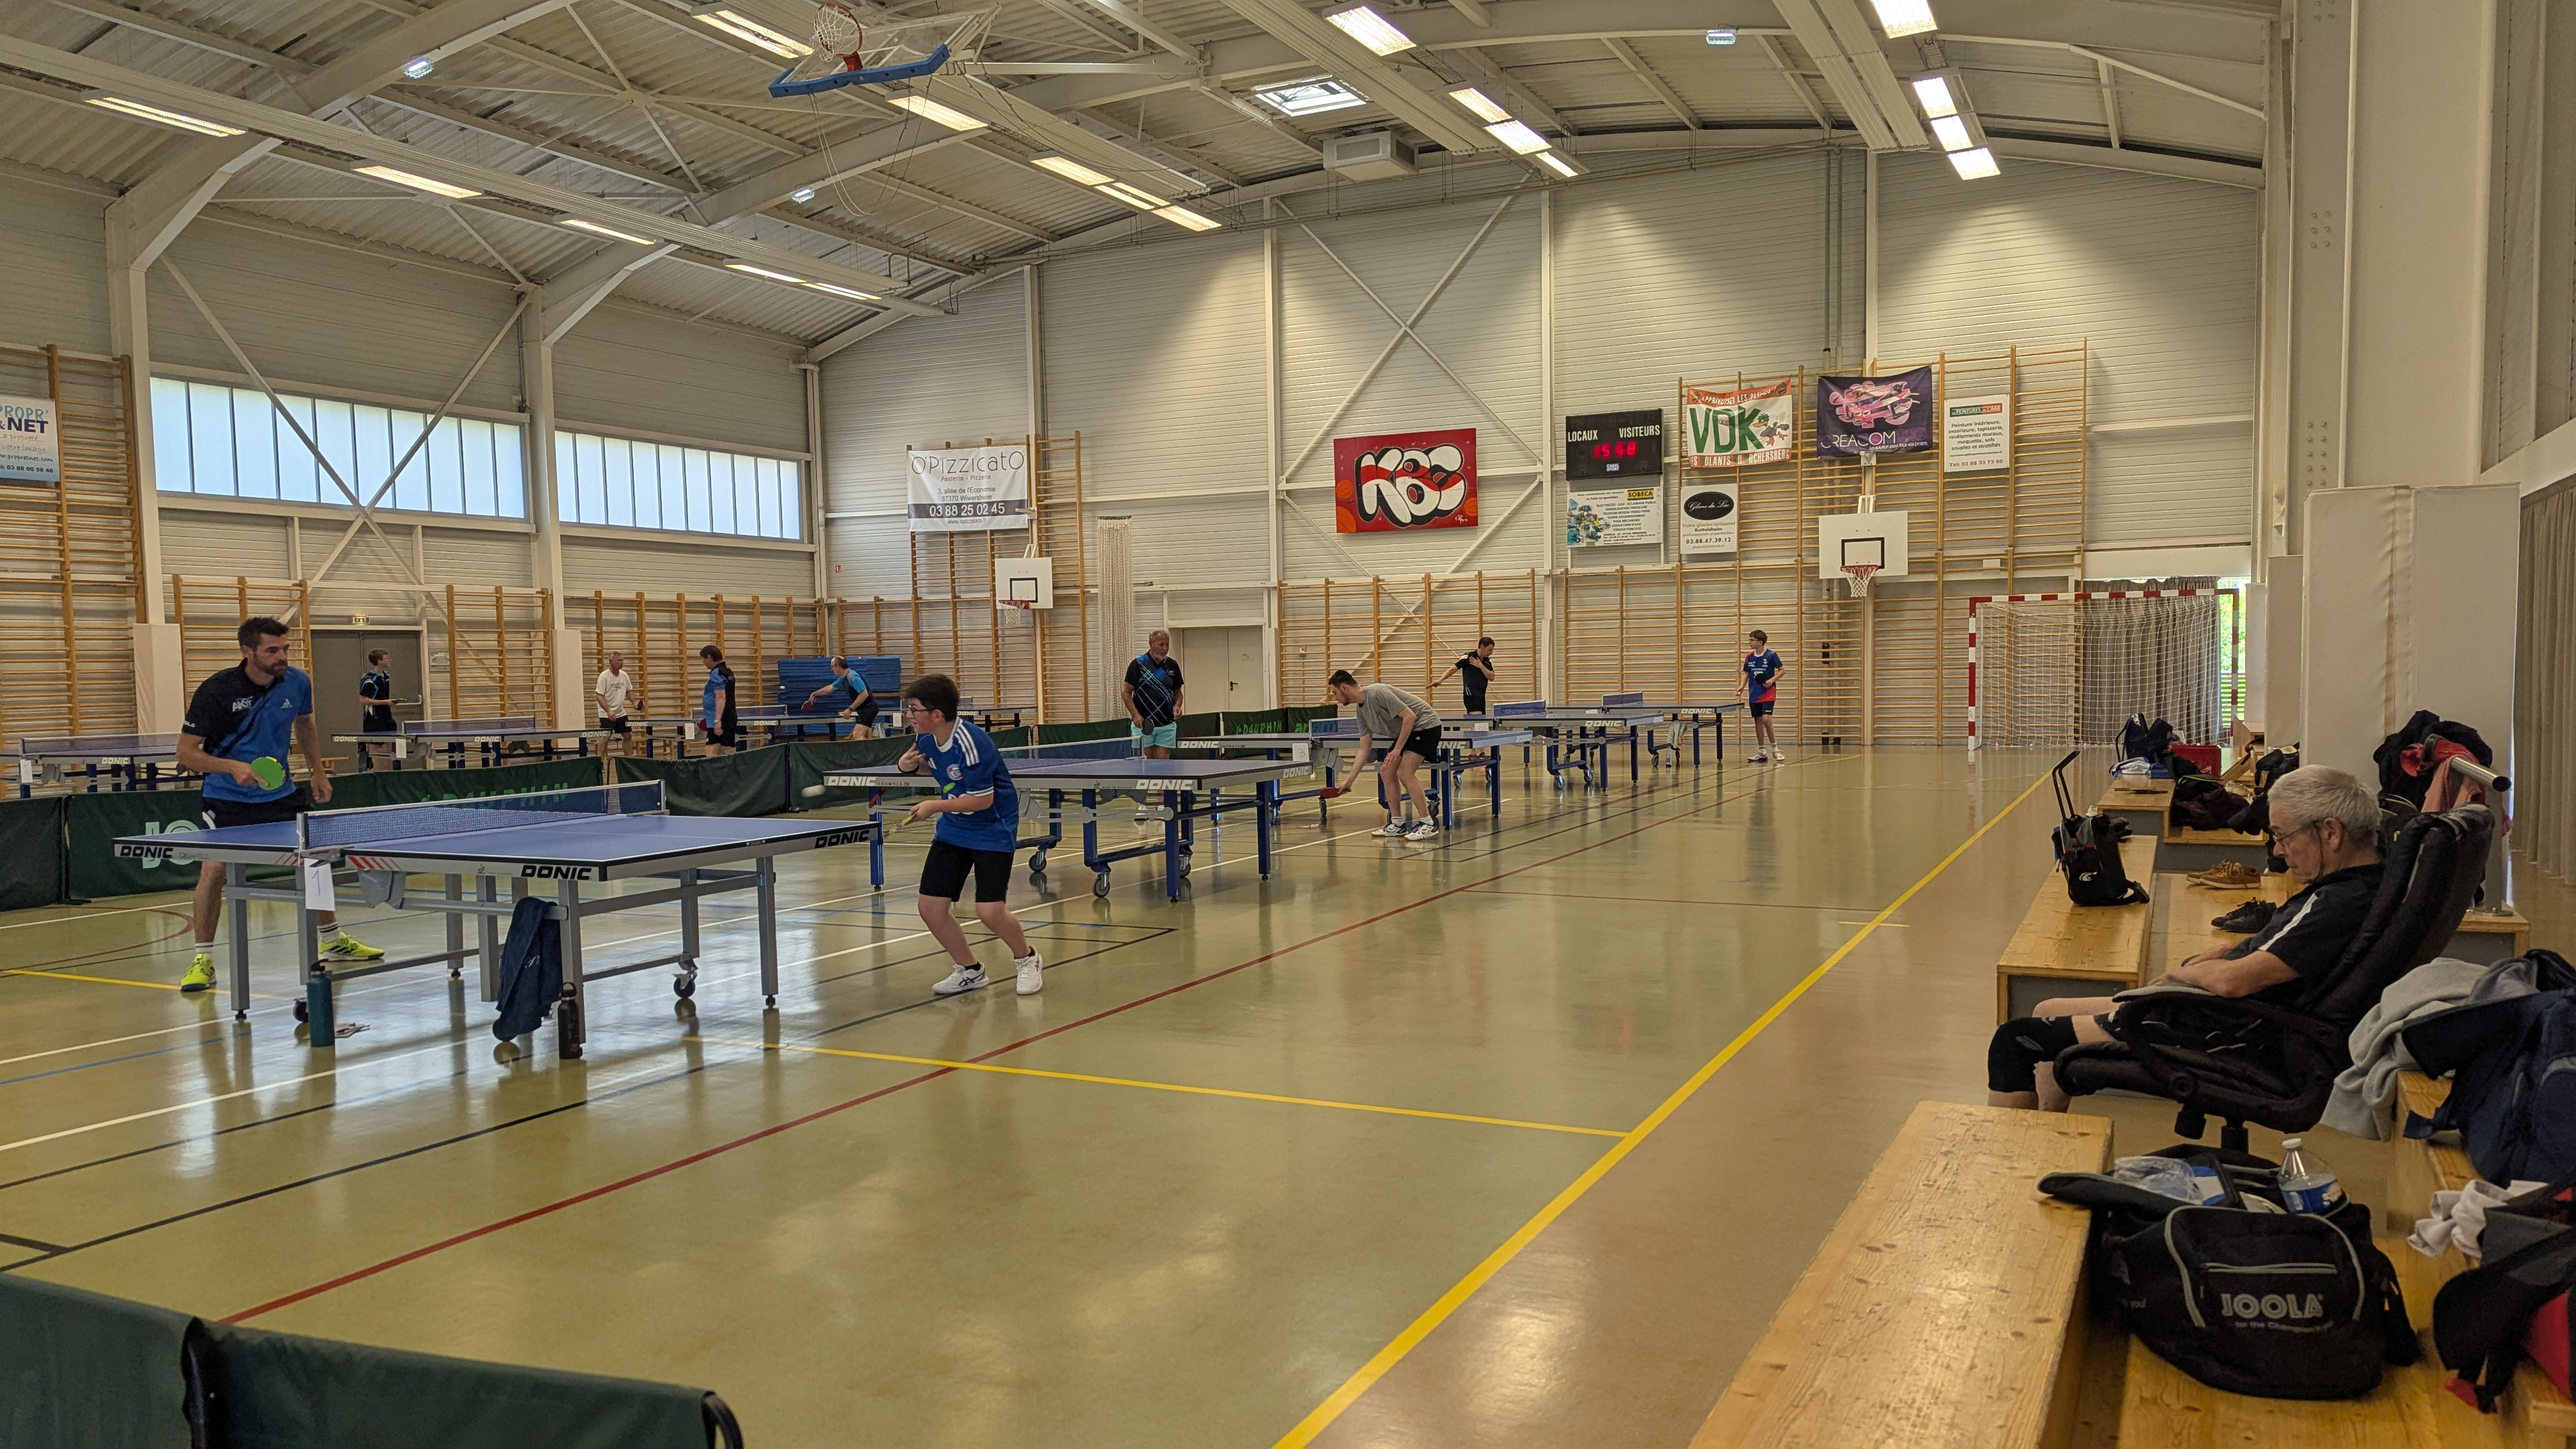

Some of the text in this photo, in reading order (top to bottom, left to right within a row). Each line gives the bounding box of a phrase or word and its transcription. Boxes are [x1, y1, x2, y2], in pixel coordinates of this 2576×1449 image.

[1701, 395, 1735, 405] APPRIVOISER
[1737, 394, 1747, 403] LES
[8, 417, 49, 433] NET
[1689, 405, 1765, 454] VDK
[1568, 425, 1660, 442] LOCAUX VISITEURS
[930, 502, 1005, 516] 03 88 25 02 45
[1243, 721, 1282, 735] DAUPHIN
[1298, 748, 1305, 757] 3
[1283, 766, 1310, 779] DONIC
[827, 776, 876, 786] DONIC
[1136, 779, 1193, 790] DONIC
[814, 830, 870, 848] DONIC
[120, 846, 173, 859] DONIC
[521, 865, 592, 880] DONIC
[311, 870, 321, 896] 1
[2221, 1293, 2324, 1319] JOOLA
